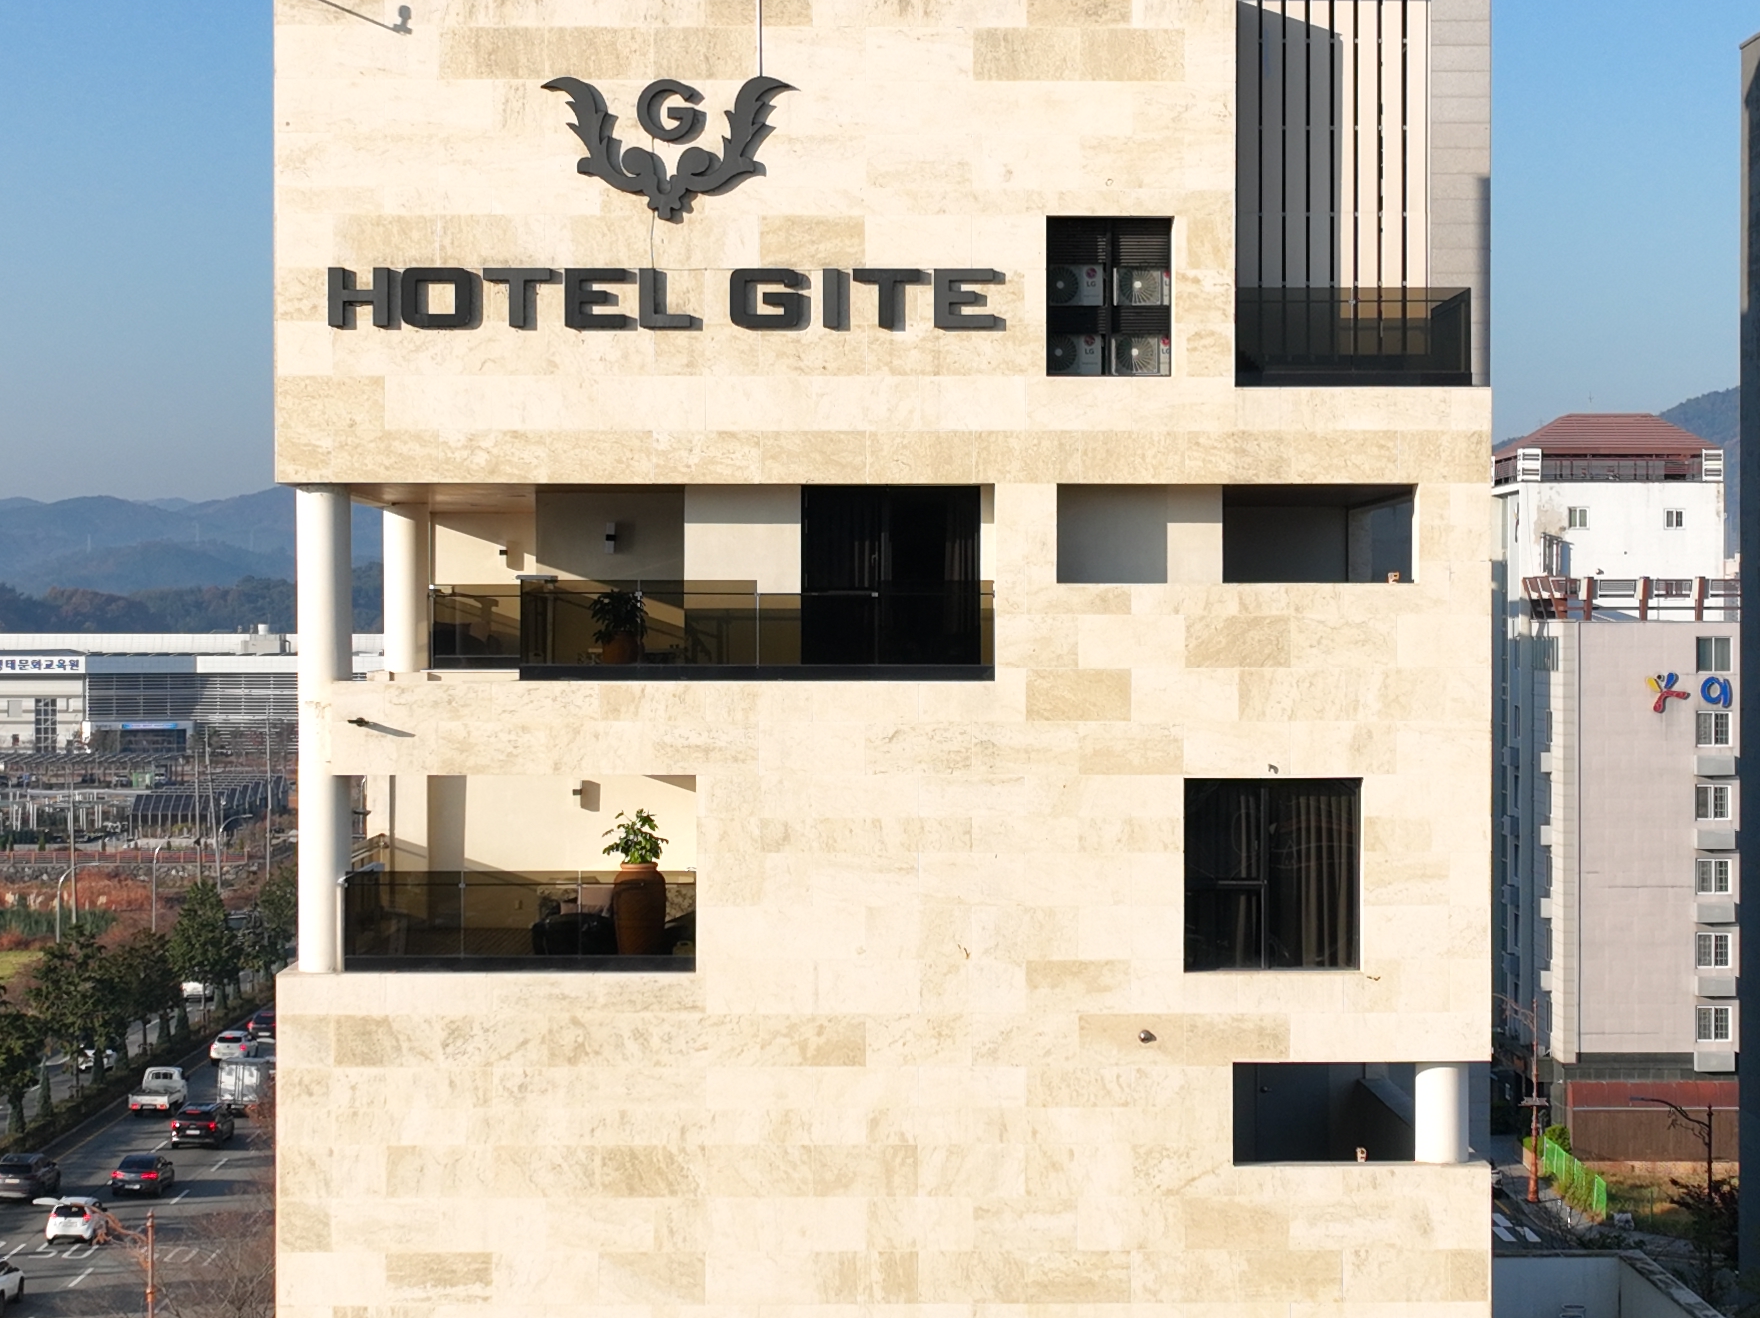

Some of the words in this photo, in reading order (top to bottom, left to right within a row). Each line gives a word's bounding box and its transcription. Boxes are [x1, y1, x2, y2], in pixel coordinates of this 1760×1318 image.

[639, 80, 704, 143] G
[327, 267, 692, 330] HOTEL
[729, 268, 1000, 330] GITE
